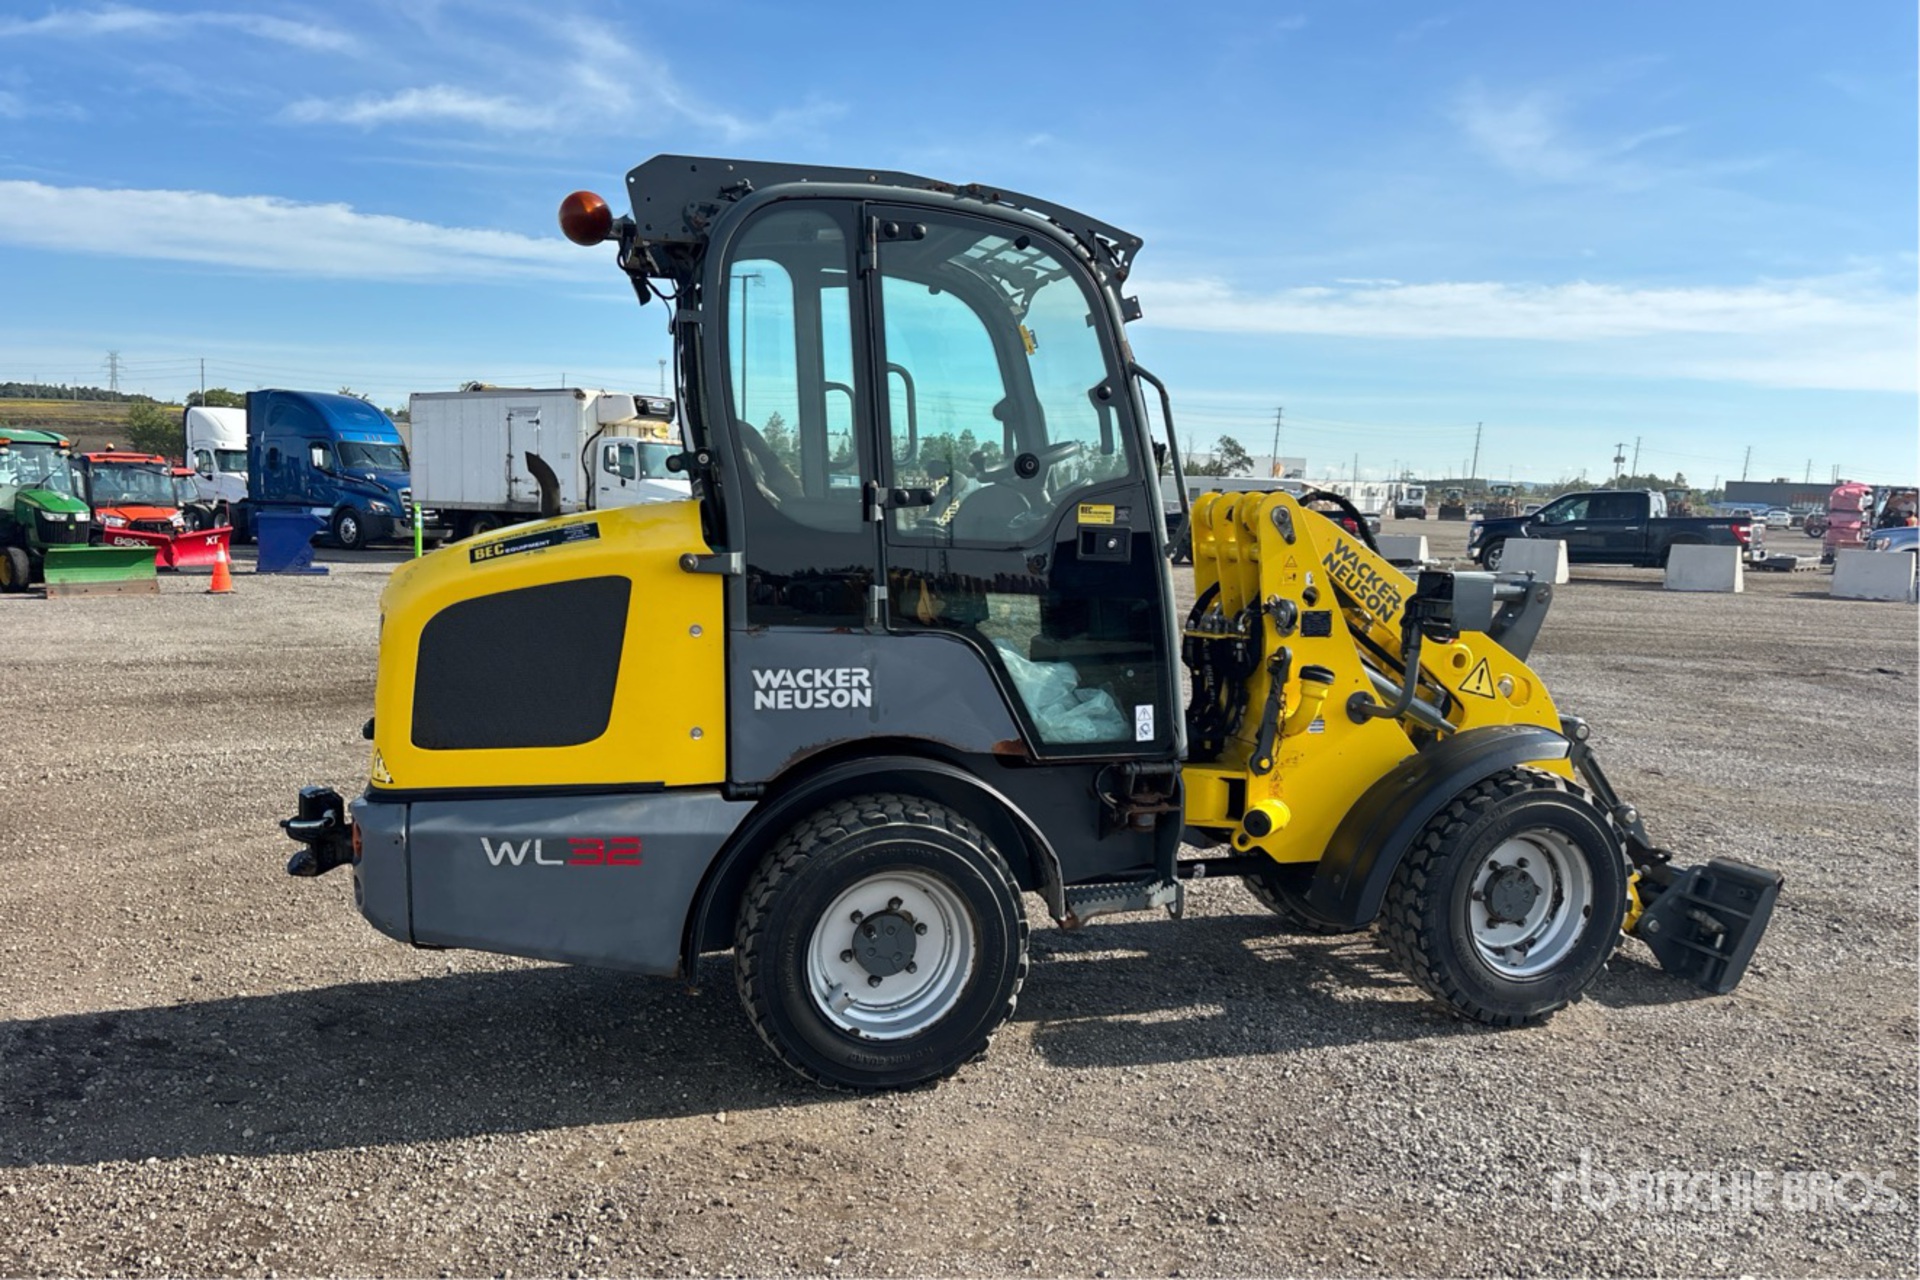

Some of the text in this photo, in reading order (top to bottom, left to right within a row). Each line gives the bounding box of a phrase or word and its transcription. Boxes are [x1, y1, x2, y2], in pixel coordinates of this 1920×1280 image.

[114, 536, 149, 548] BOSS
[205, 534, 221, 546] XT
[474, 543, 504, 560] BEC
[504, 539, 551, 554] EQUIPMENT
[1334, 537, 1402, 610] WACKER
[1322, 552, 1394, 623] NEUSON
[752, 668, 872, 689] WACKER
[754, 688, 872, 710] NEUSON
